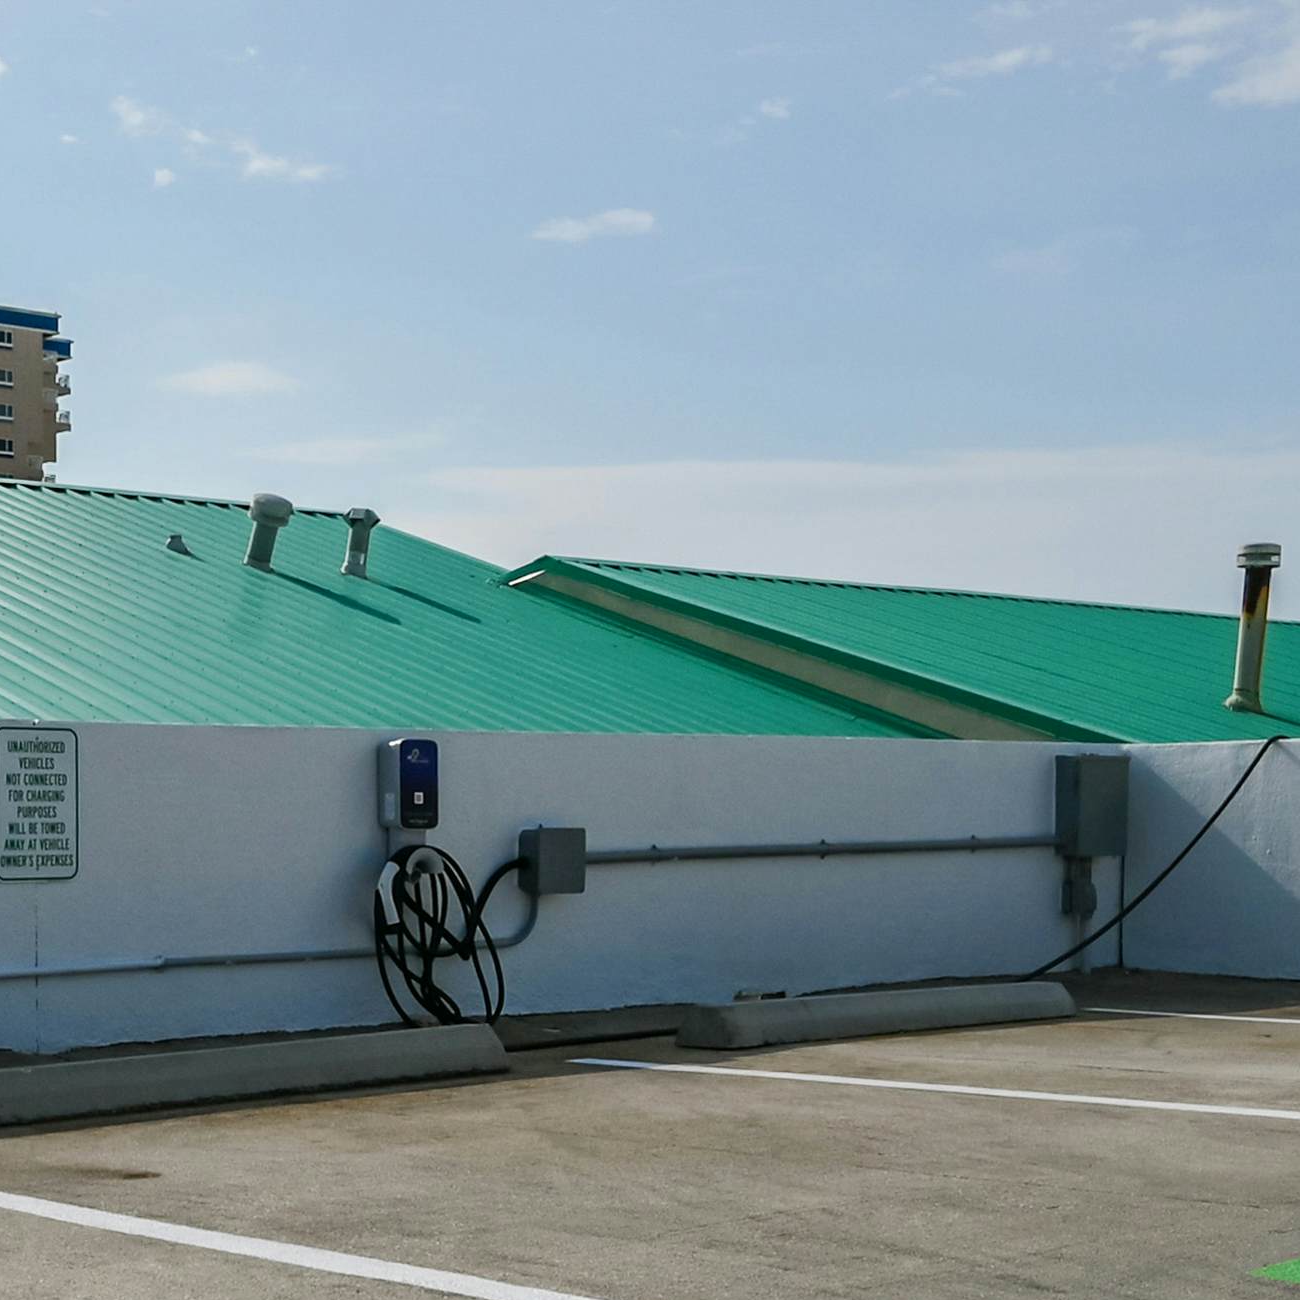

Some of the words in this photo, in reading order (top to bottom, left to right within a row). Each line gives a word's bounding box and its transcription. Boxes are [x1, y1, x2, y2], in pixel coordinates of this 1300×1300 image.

[7, 740, 65, 754] UNAUTHORIZED
[19, 757, 55, 770] VEHICLES
[6, 773, 21, 786] NOT
[24, 773, 67, 786] CONNECTED
[8, 790, 24, 802] FOR
[26, 790, 65, 802] CHARGING
[17, 806, 57, 818] PURPOSES
[8, 822, 26, 835] WILL
[29, 822, 38, 834] BE
[41, 822, 65, 834] TOWED
[4, 839, 25, 850] AWAY
[28, 839, 37, 850] AT
[40, 838, 70, 850] VEHICLE
[1, 855, 33, 867] OWNER'S
[36, 854, 74, 867] EXPENSES
